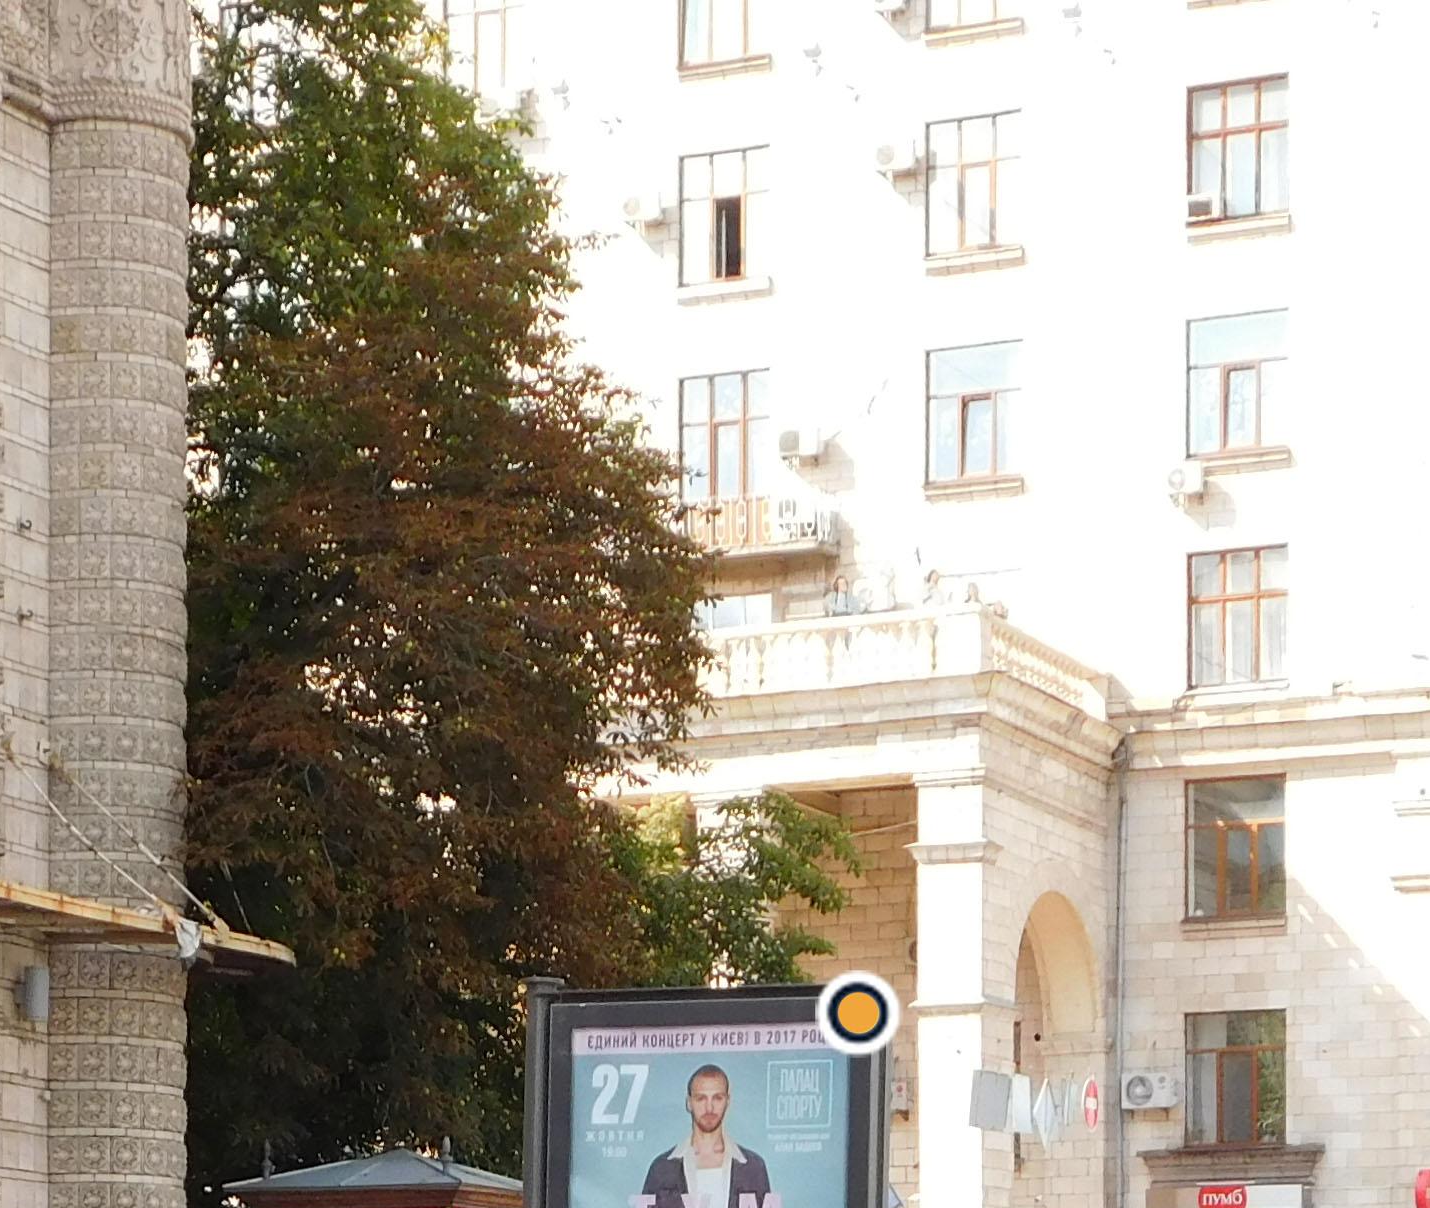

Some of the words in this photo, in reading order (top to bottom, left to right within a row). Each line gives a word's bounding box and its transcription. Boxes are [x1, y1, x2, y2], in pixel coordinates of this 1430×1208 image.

[587, 1032, 638, 1050] ЄДИНИЙ
[642, 1032, 694, 1050] КОНЦЕРТ
[700, 1032, 707, 1047] У
[754, 1031, 761, 1045] В
[766, 1029, 796, 1044] 2017
[801, 1029, 826, 1045] РОЦ
[591, 1063, 650, 1125] 27
[779, 1068, 820, 1094] ПАЛАЦ
[776, 1095, 822, 1121] СПОРТУ
